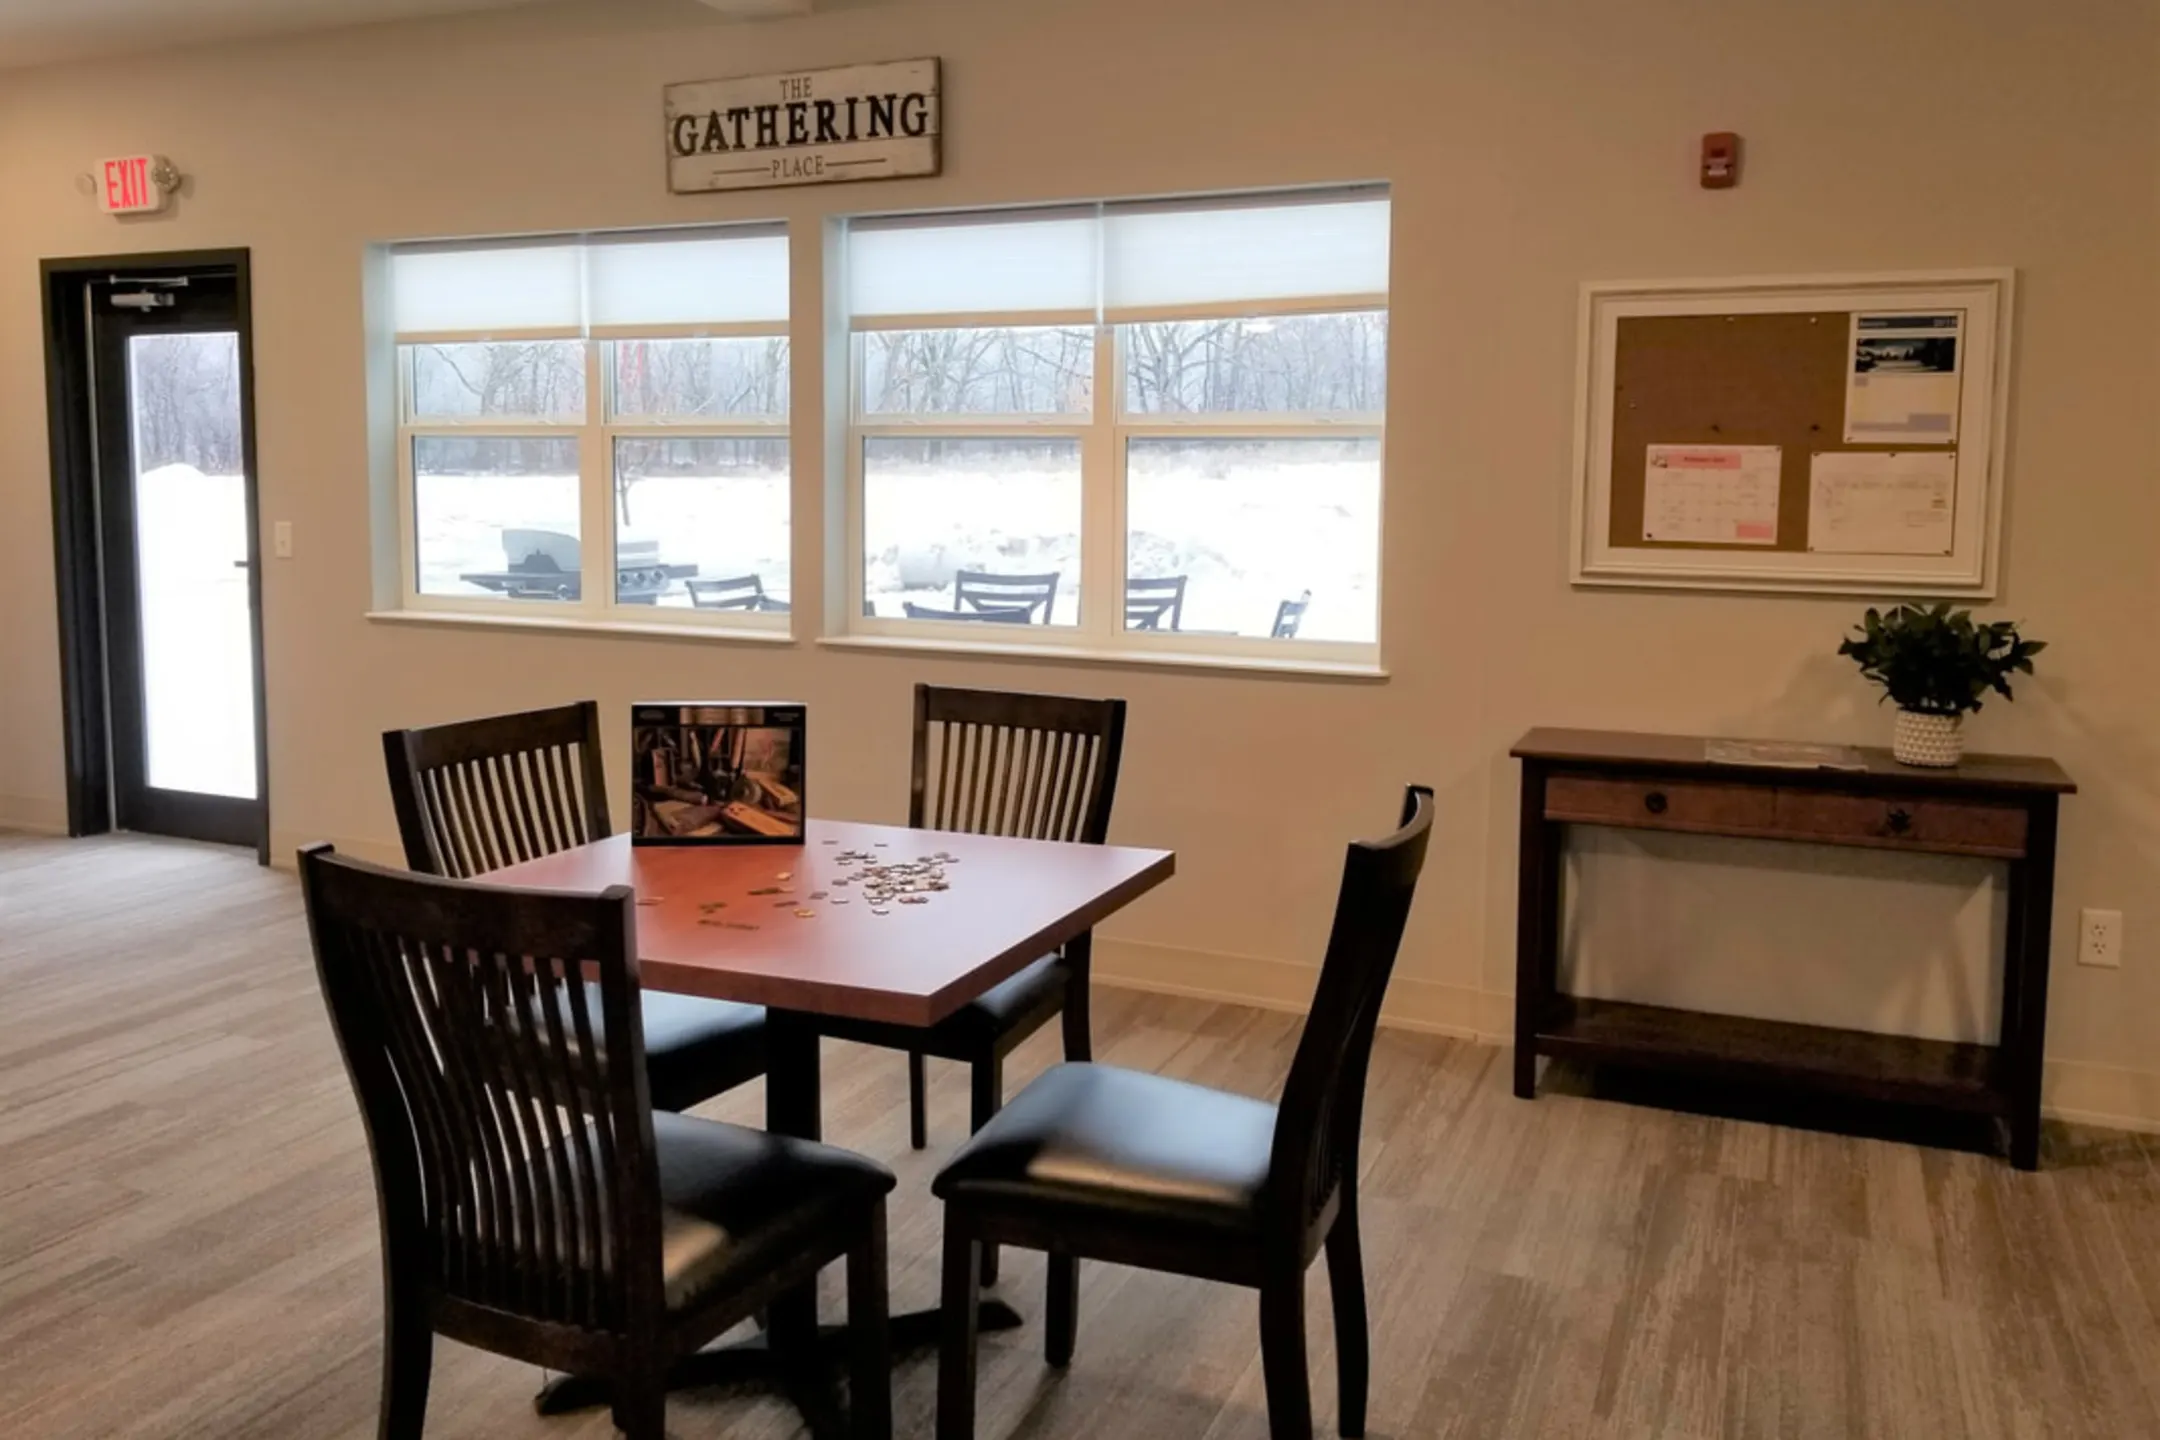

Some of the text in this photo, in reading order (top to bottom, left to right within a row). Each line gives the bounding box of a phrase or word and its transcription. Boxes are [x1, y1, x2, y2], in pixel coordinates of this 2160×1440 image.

[780, 77, 812, 101] THE
[673, 93, 928, 156] GATHERING
[104, 157, 149, 209] EXIT
[771, 156, 825, 179] PLACE
